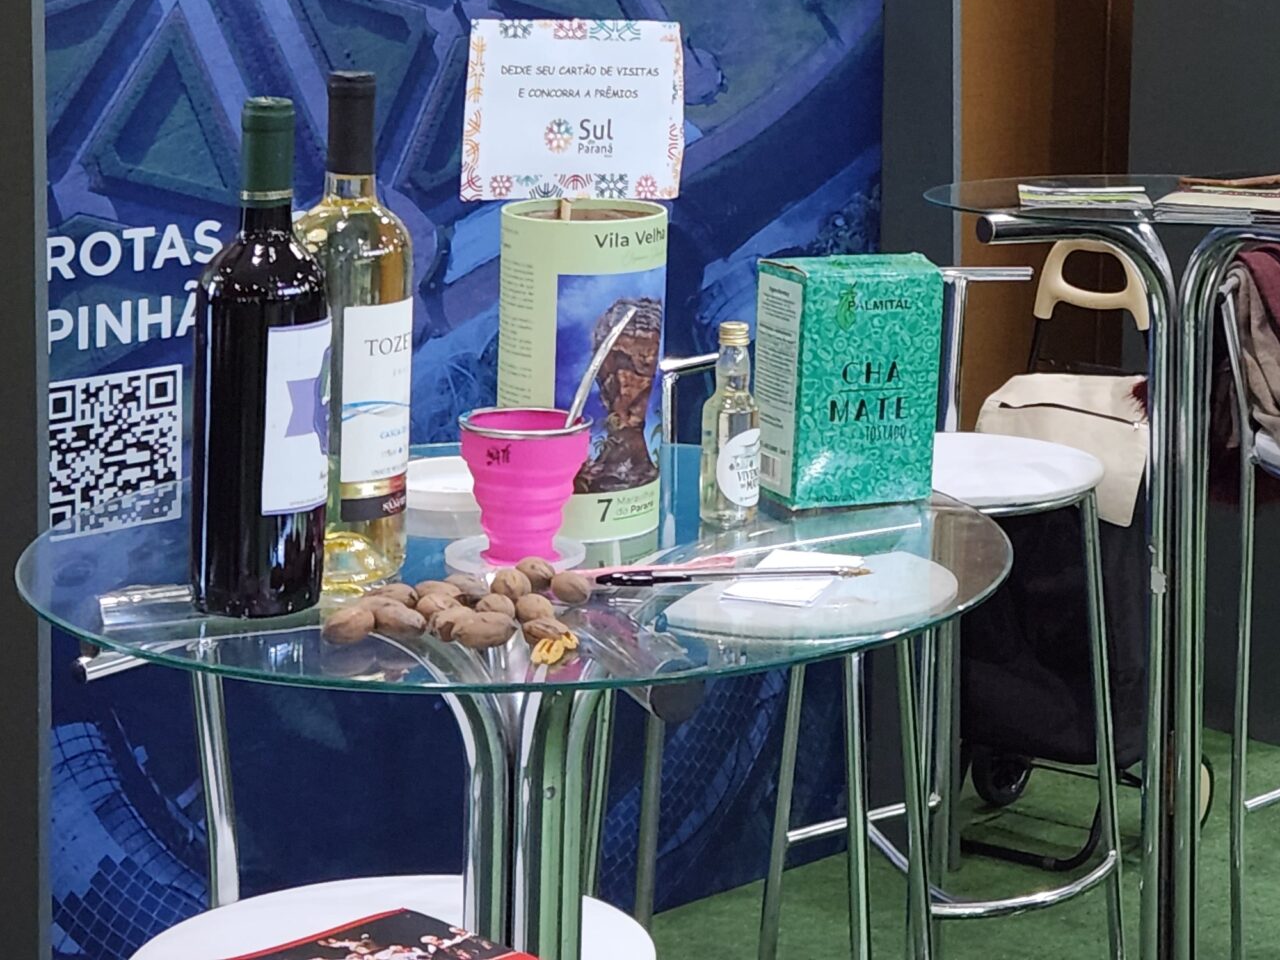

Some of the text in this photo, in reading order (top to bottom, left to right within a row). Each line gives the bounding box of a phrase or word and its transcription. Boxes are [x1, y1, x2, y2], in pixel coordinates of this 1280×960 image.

[501, 64, 660, 77] DEIXE SEU CARTÃO DE VISITAS
[518, 86, 638, 99] E CONCORRA A PRÊMIOS
[579, 118, 613, 140] Sul
[578, 143, 613, 154] Paraná
[594, 227, 665, 249] Vila Velha
[46, 220, 223, 281] ROTAS
[848, 299, 912, 311] PALMITAL
[364, 332, 411, 356] TOZE
[829, 394, 910, 423] MATE
[597, 498, 614, 523] 7
